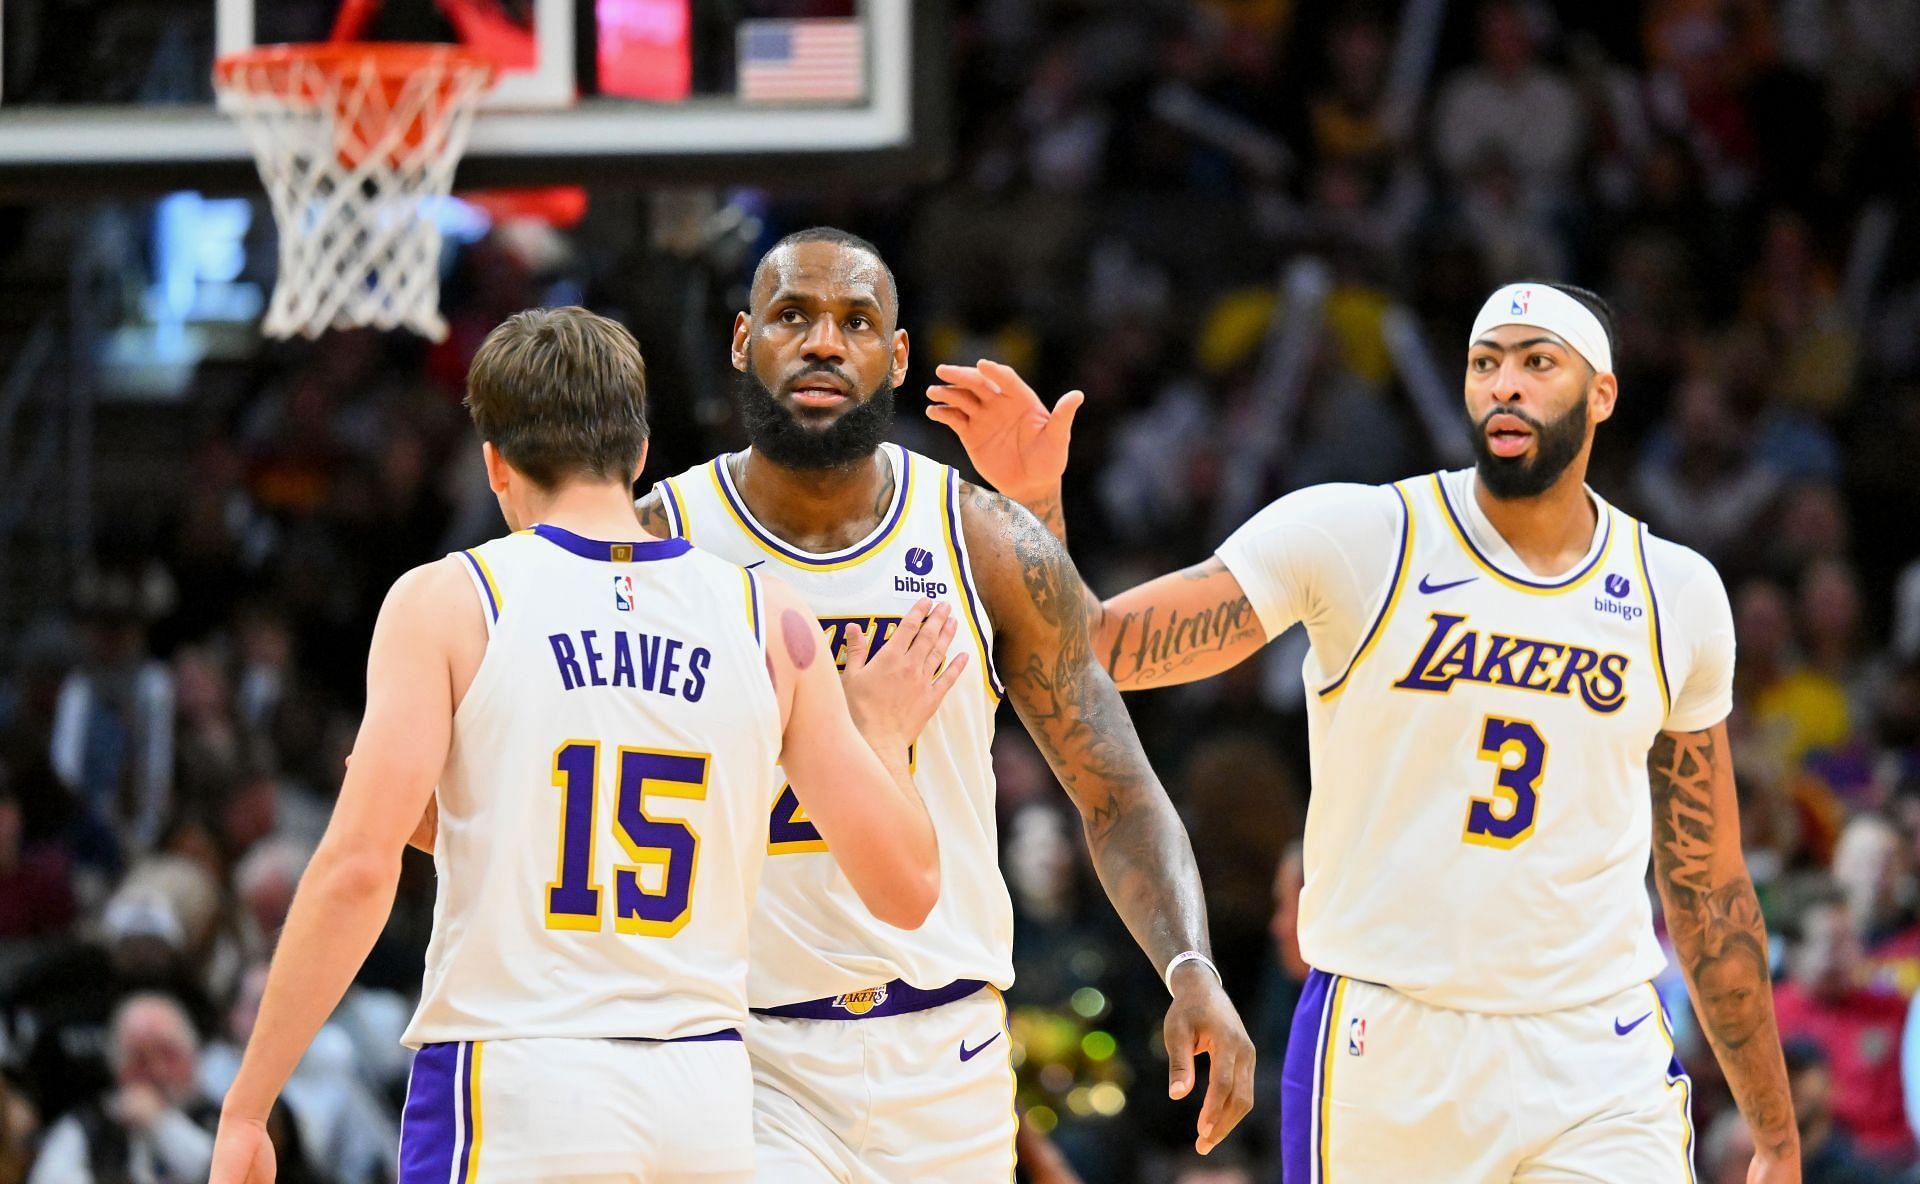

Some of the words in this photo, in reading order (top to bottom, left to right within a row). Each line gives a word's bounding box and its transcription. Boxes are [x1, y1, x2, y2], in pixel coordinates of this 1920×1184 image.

[894, 576, 948, 599] bibigo
[1594, 596, 1643, 621] bibigo
[548, 629, 711, 703] REAVES
[1108, 595, 1251, 683] Chicago
[1389, 610, 1632, 716] LAKERS
[1461, 713, 1549, 851] 3
[545, 738, 712, 939] 15
[835, 989, 886, 1006] LAKERS
